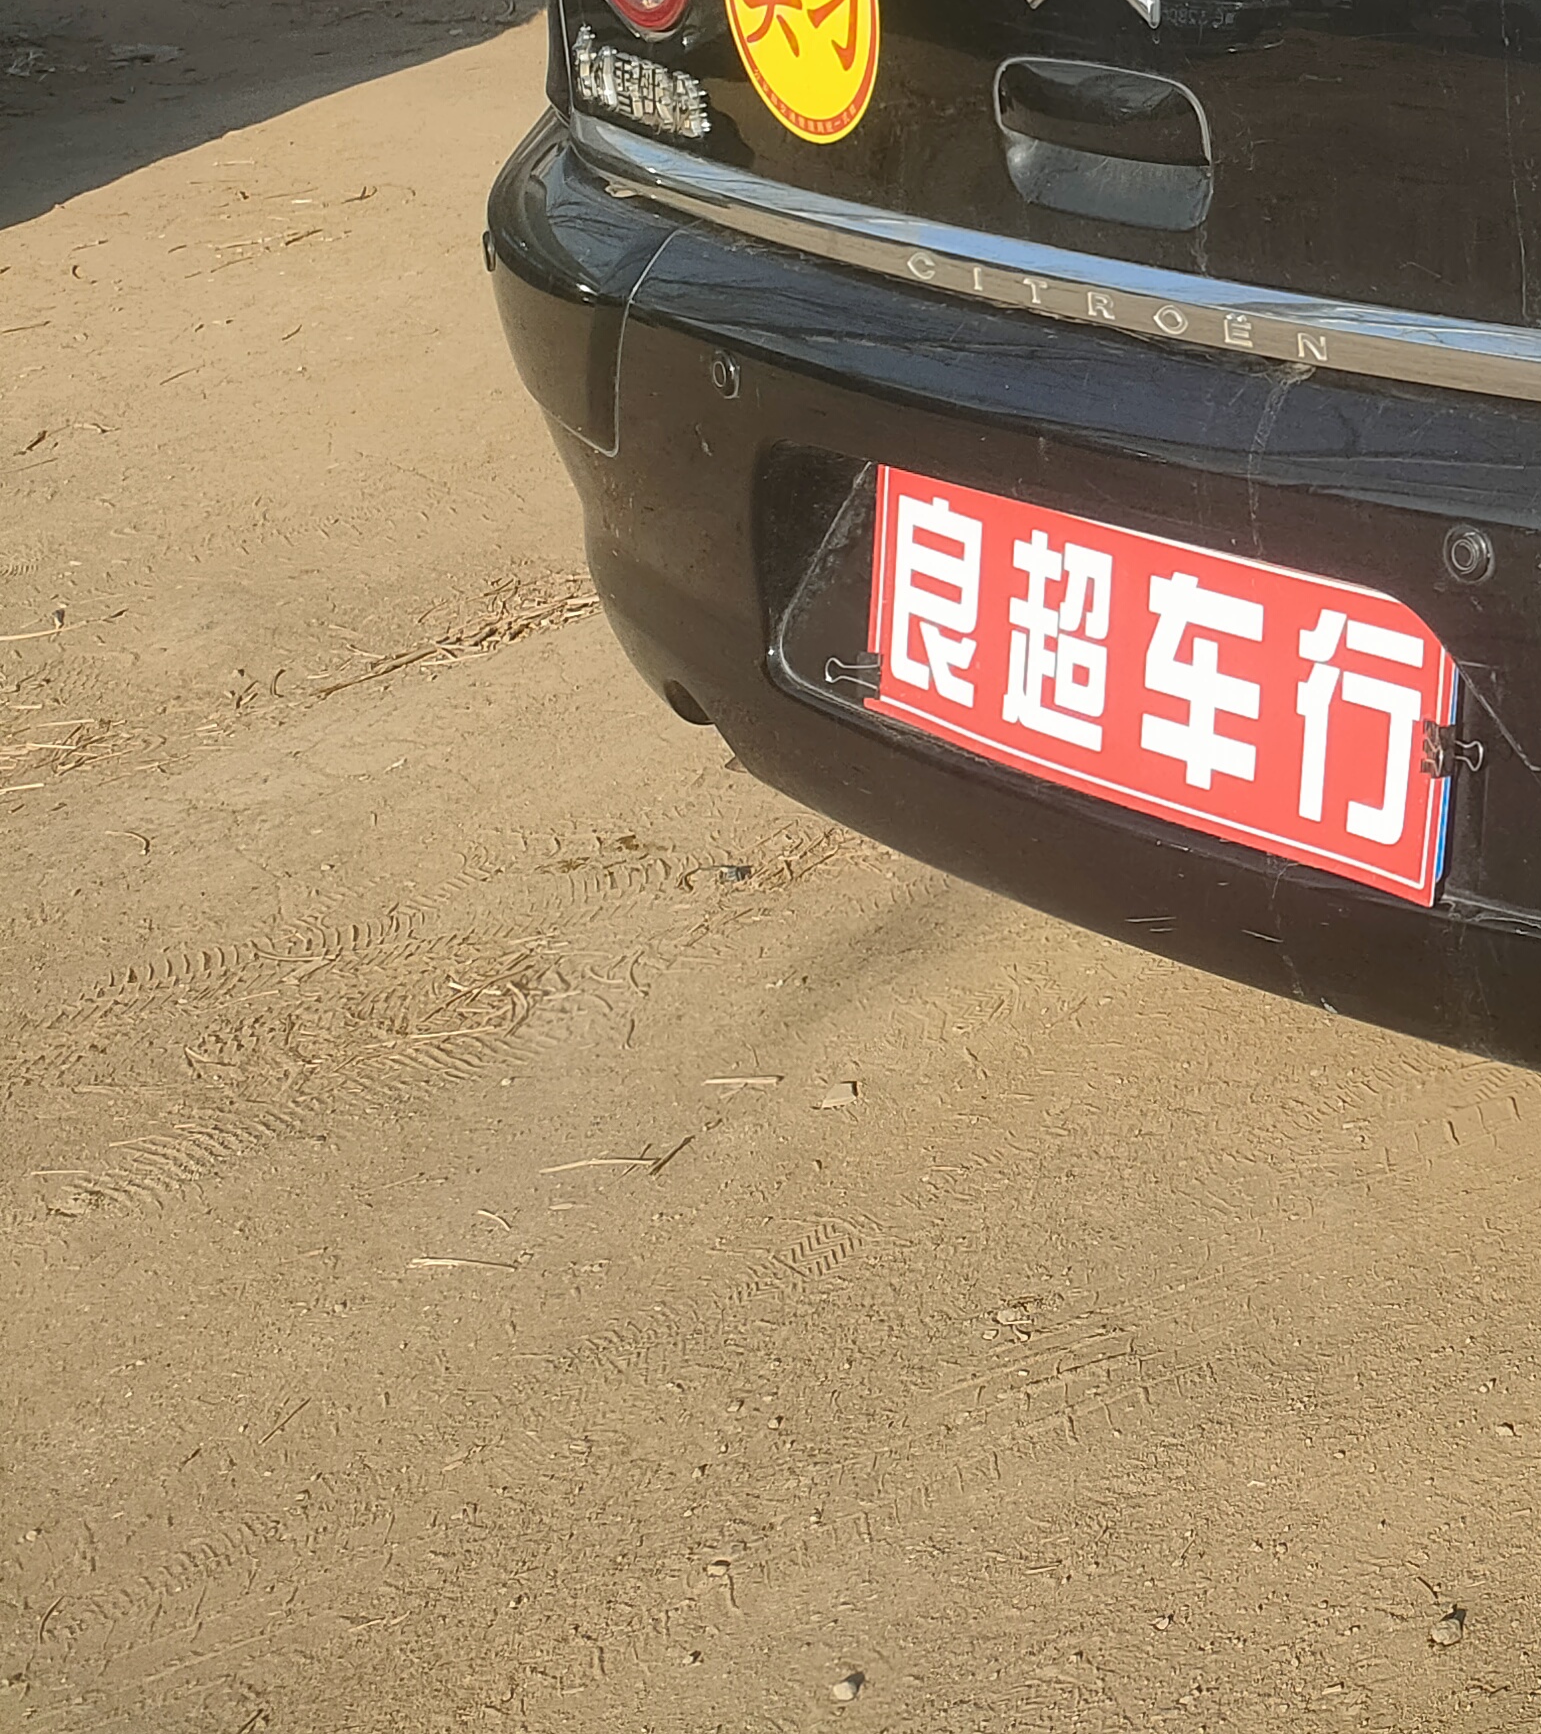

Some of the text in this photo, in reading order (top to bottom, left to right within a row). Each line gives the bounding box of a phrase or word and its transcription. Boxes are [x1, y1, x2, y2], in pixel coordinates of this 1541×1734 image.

[906, 250, 1330, 363] CITROËN
[889, 493, 1425, 846] 良超车行
